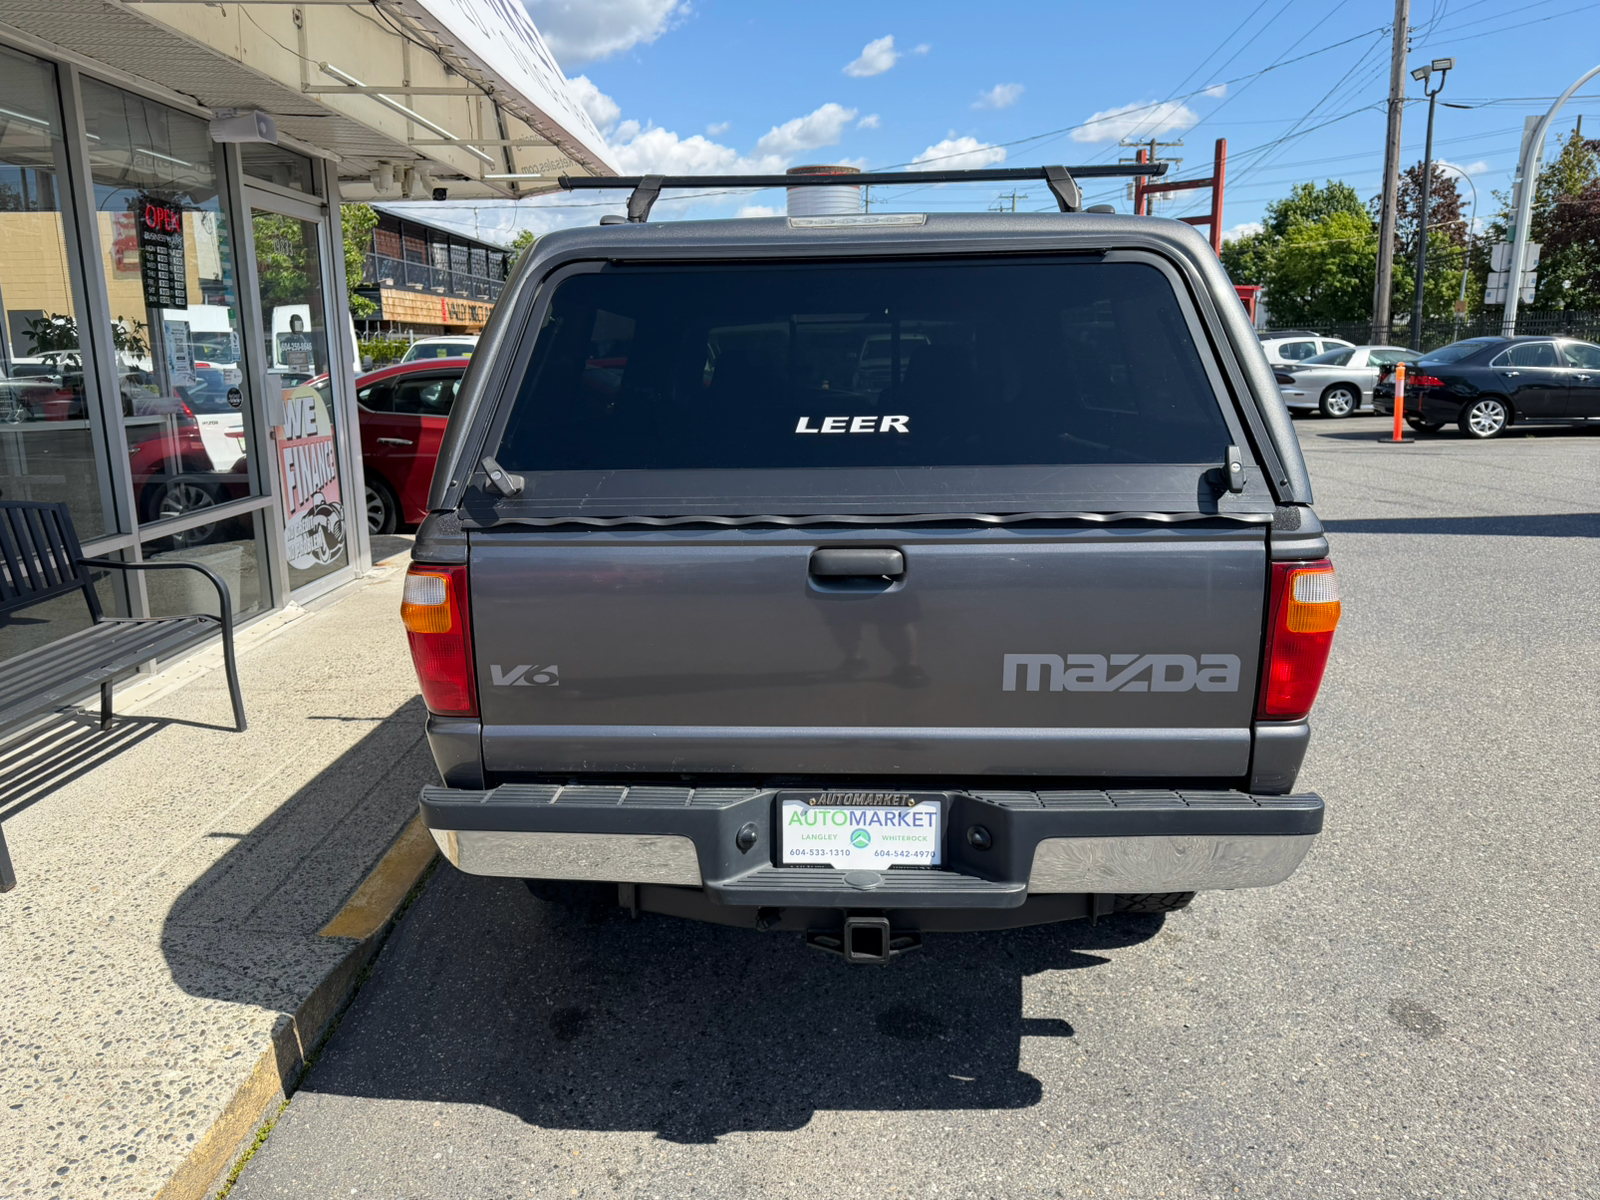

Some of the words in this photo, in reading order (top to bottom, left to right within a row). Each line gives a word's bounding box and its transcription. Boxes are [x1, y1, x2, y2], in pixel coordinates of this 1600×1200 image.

[145, 204, 181, 232] OPEN
[283, 396, 318, 440] WE
[795, 415, 910, 433] LEER
[282, 440, 335, 514] FINANCE
[287, 525, 295, 542] NO
[287, 545, 296, 561] NO
[490, 664, 560, 686] V6
[1002, 653, 1241, 692] mazda
[817, 793, 910, 806] AUTOMARKET
[788, 810, 937, 827] AUTOMARKET
[789, 848, 851, 857] 604-533-1310
[874, 850, 936, 858] 604-542-4970
